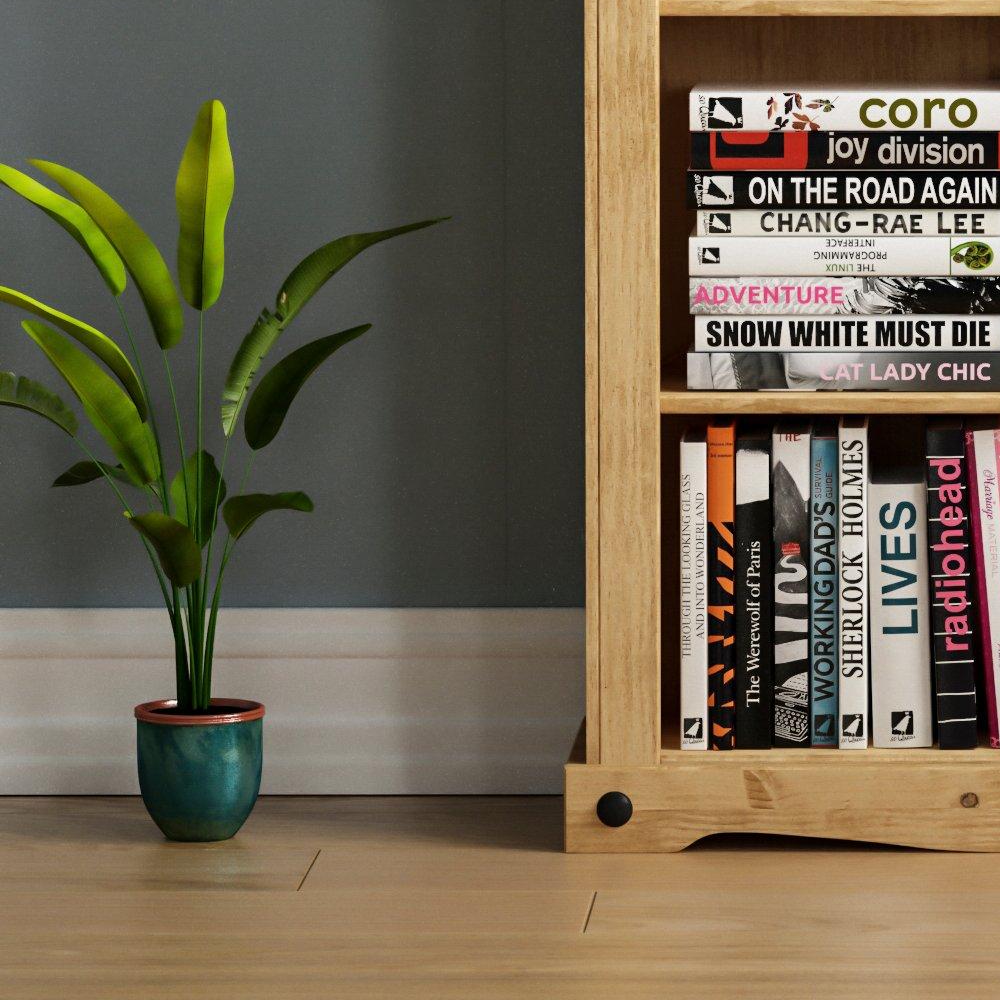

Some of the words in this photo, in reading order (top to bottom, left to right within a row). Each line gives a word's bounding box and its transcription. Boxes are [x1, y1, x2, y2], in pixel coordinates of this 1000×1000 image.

[859, 97, 978, 128] coro
[826, 132, 869, 164] joy
[878, 136, 984, 164] division
[748, 177, 782, 204] ON
[791, 177, 841, 204] THE
[845, 177, 915, 204] ROAD
[921, 177, 997, 204] AGAIN
[760, 212, 923, 234] CHANG-RAE
[937, 212, 985, 234] LEE
[813, 250, 887, 260] PROGRAMMING
[825, 239, 875, 247] INTERFACE
[826, 263, 854, 272] LINUX
[857, 264, 875, 272] THE
[695, 286, 844, 305] ADVENTURE
[707, 321, 782, 347] SNOW
[789, 321, 869, 347] WHITE
[875, 321, 946, 347] MUST
[952, 321, 991, 347] DIE
[820, 363, 864, 381] CAT
[869, 363, 930, 381] LADY
[937, 362, 991, 381] CHIC
[681, 473, 691, 512] GLASS
[814, 457, 822, 499] SURVIVAL
[825, 472, 833, 499] GUIDE
[841, 440, 863, 536] HOLMES
[982, 469, 996, 519] Marriage
[681, 515, 692, 571] LOOKING
[695, 492, 705, 579] WONDERLAND
[988, 524, 998, 578] MATERIAL
[747, 541, 761, 577] Paris
[879, 501, 919, 635] LIVES
[930, 458, 969, 651] radiohead
[681, 574, 691, 596] THE
[695, 581, 705, 610] INTO
[746, 580, 760, 598] of
[681, 600, 692, 658] THROUGH
[695, 612, 704, 640] AND
[842, 553, 863, 678] SHERLOCK
[747, 601, 761, 671] Werewolf
[814, 581, 835, 701] WORKING
[747, 675, 760, 707] The
